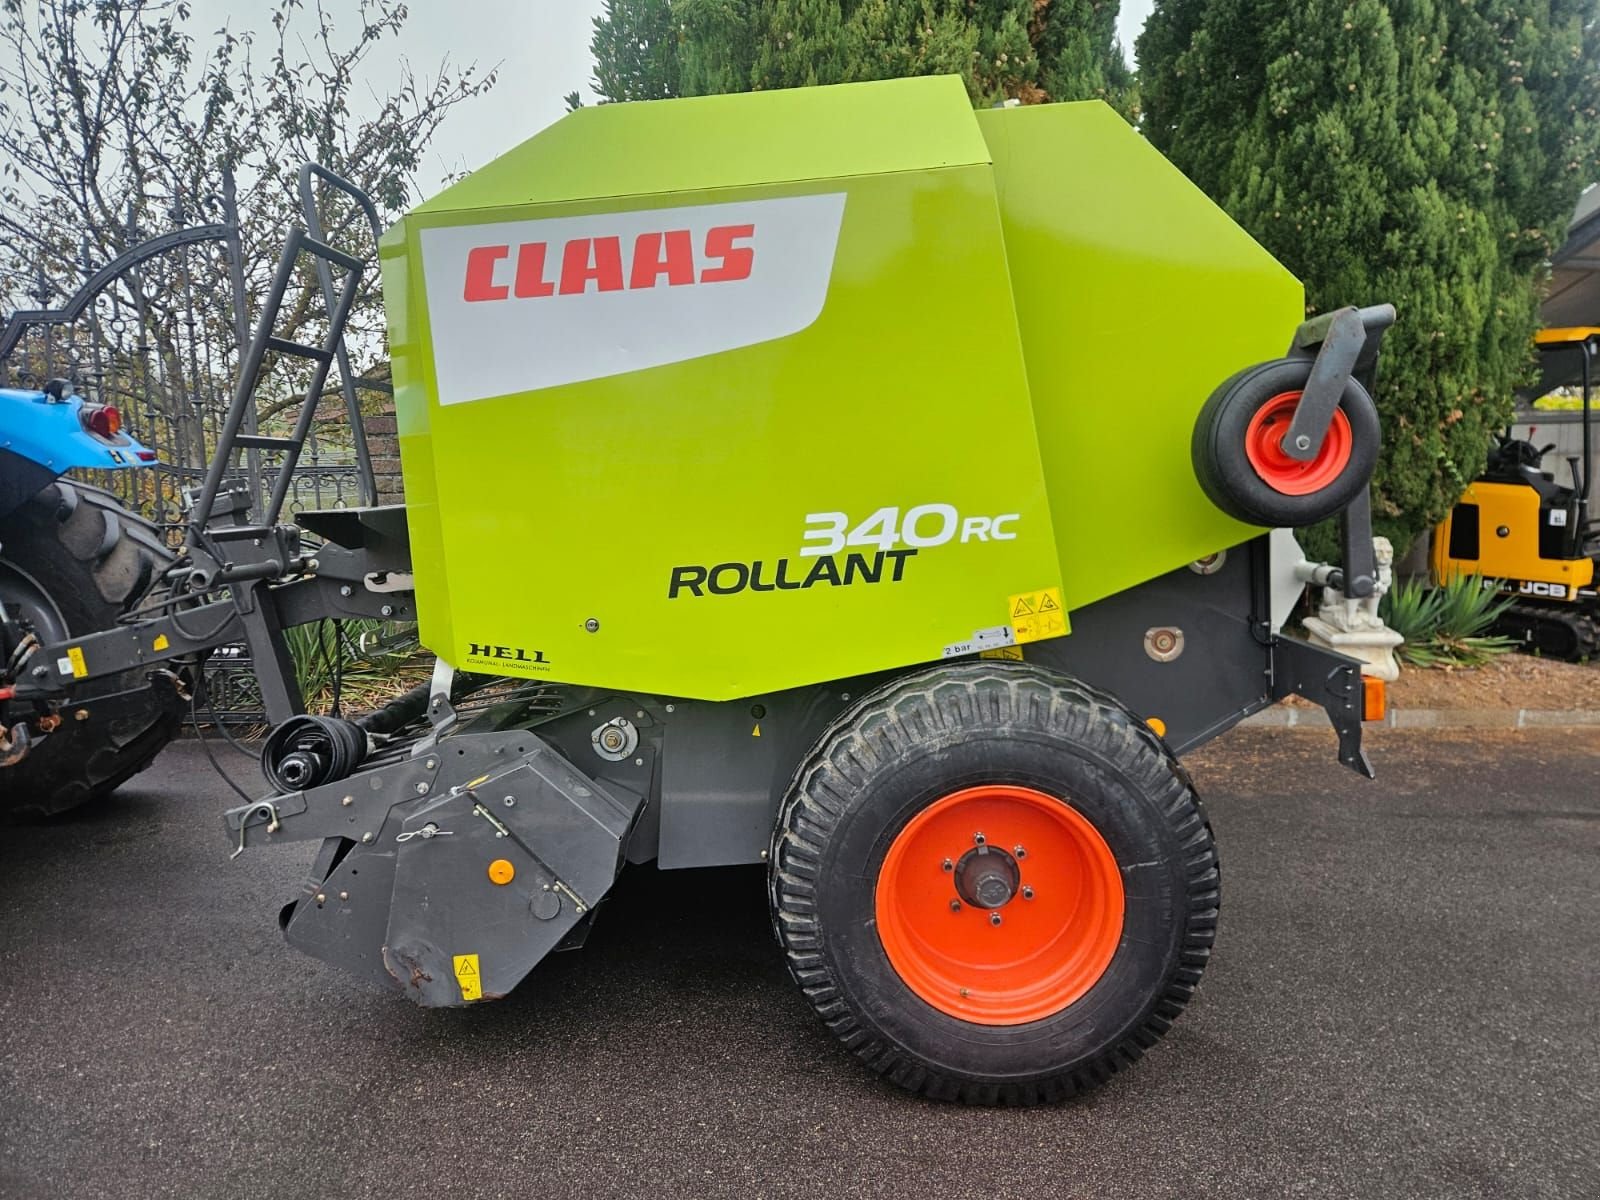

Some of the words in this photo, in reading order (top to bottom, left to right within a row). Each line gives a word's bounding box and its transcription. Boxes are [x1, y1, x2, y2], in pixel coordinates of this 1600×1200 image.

[464, 223, 755, 303] CLAAS
[668, 548, 919, 600] ROLLANT
[1520, 581, 1566, 598] JCB
[469, 643, 551, 663] HELL
[955, 645, 971, 653] bar
